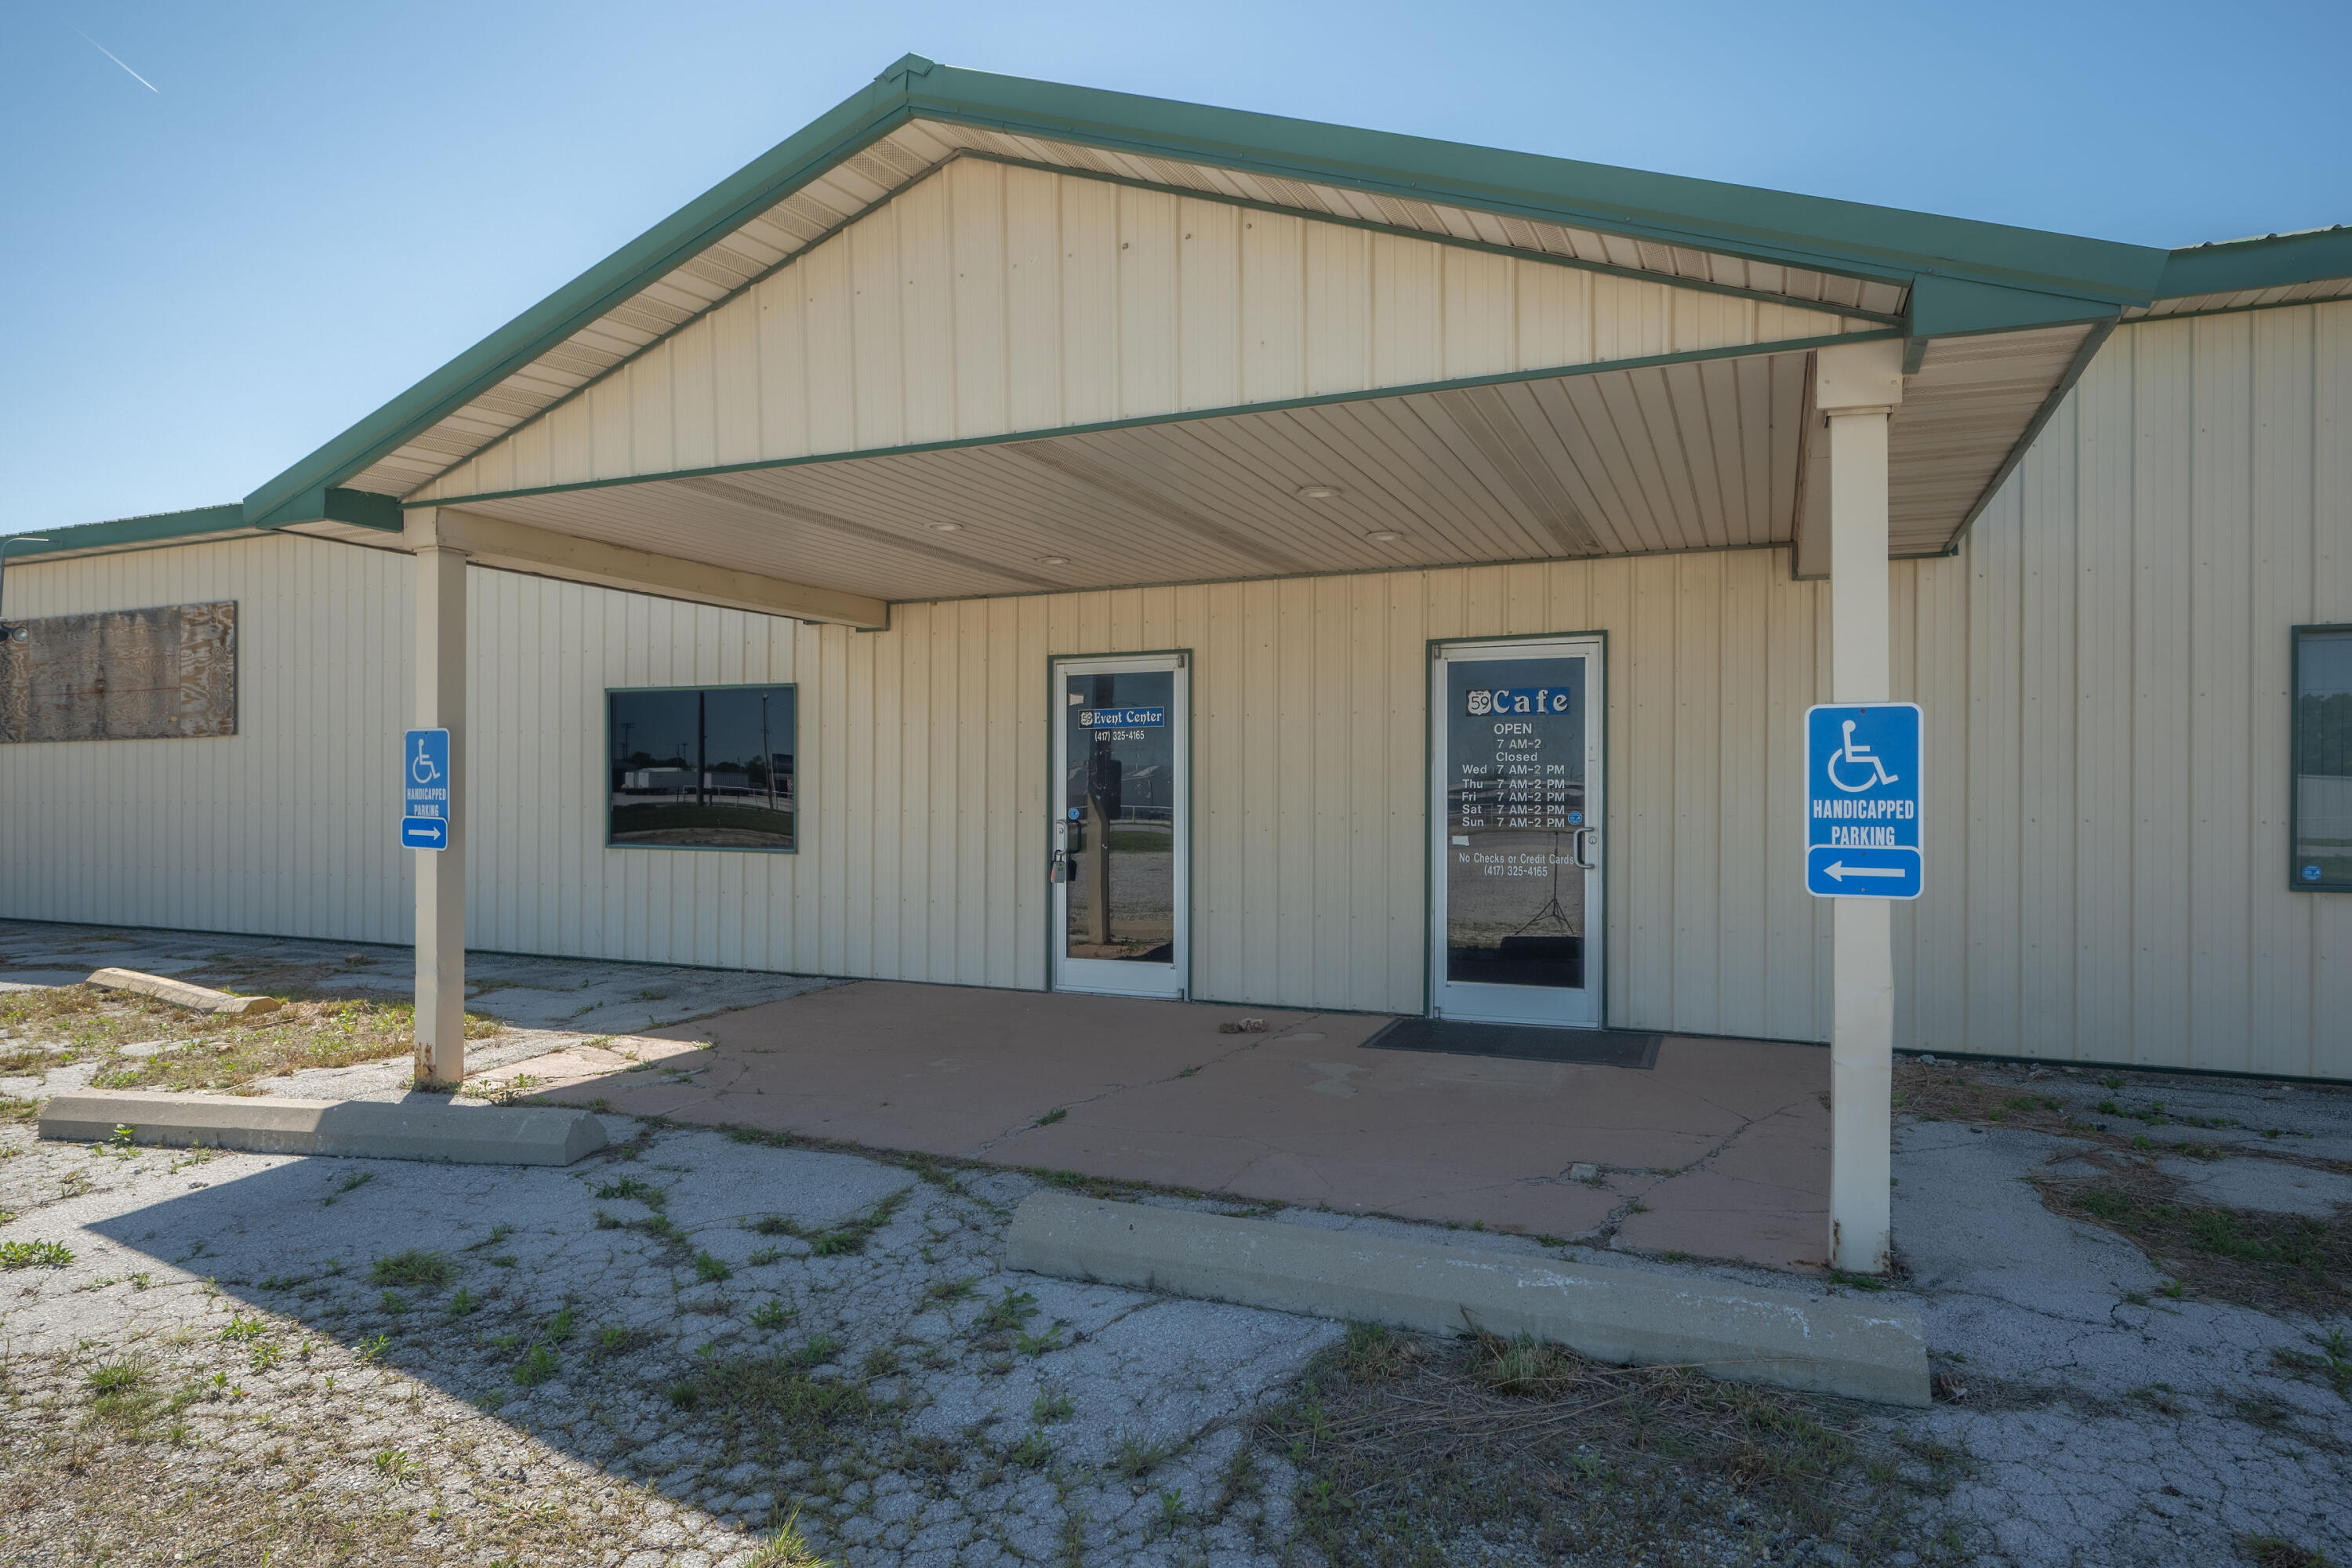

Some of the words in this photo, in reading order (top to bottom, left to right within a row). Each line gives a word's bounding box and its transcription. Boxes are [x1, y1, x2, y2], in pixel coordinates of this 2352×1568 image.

[1472, 696, 1490, 710] 59
[1493, 689, 1569, 713] Cafe
[1082, 714, 1093, 724] 59
[1094, 712, 1123, 725] Event
[1127, 710, 1162, 724] Center
[1494, 723, 1532, 735] OPEN
[1094, 731, 1111, 742] (417)
[1113, 730, 1145, 741] 325-4165
[1497, 739, 1504, 749] 7
[1509, 739, 1541, 749] AM-2
[1496, 752, 1537, 761] Closed
[1462, 764, 1487, 774] Wed
[1497, 764, 1504, 775] 7
[1509, 764, 1541, 775] AM-2
[1547, 764, 1565, 775] PM
[1462, 779, 1483, 789] Thu
[1497, 779, 1504, 789] 7
[1509, 779, 1541, 789] AM-2
[1547, 779, 1565, 789] PM
[407, 788, 446, 800] HANDICAPPED
[1462, 792, 1476, 801] Fri
[1497, 792, 1504, 801] 7
[1509, 792, 1541, 801] AM-2
[1547, 792, 1565, 801] PM
[414, 804, 439, 817] PARKING
[1462, 804, 1482, 814] Sat
[1497, 804, 1504, 815] 7
[1509, 804, 1541, 815] AM-2
[1547, 804, 1565, 815] PM
[1813, 800, 1914, 819] HANDICAPPED
[1462, 817, 1484, 827] Sun
[1497, 818, 1504, 828] 7
[1509, 818, 1541, 828] AM-2
[1547, 818, 1565, 828] PM
[1831, 826, 1895, 845] PARKING
[1459, 853, 1471, 862] No
[1474, 852, 1504, 863] Checks
[1520, 853, 1545, 863] Credit
[1549, 854, 1573, 864] Cards
[1484, 865, 1504, 877] (417)
[1508, 866, 1548, 877] 325-4165
